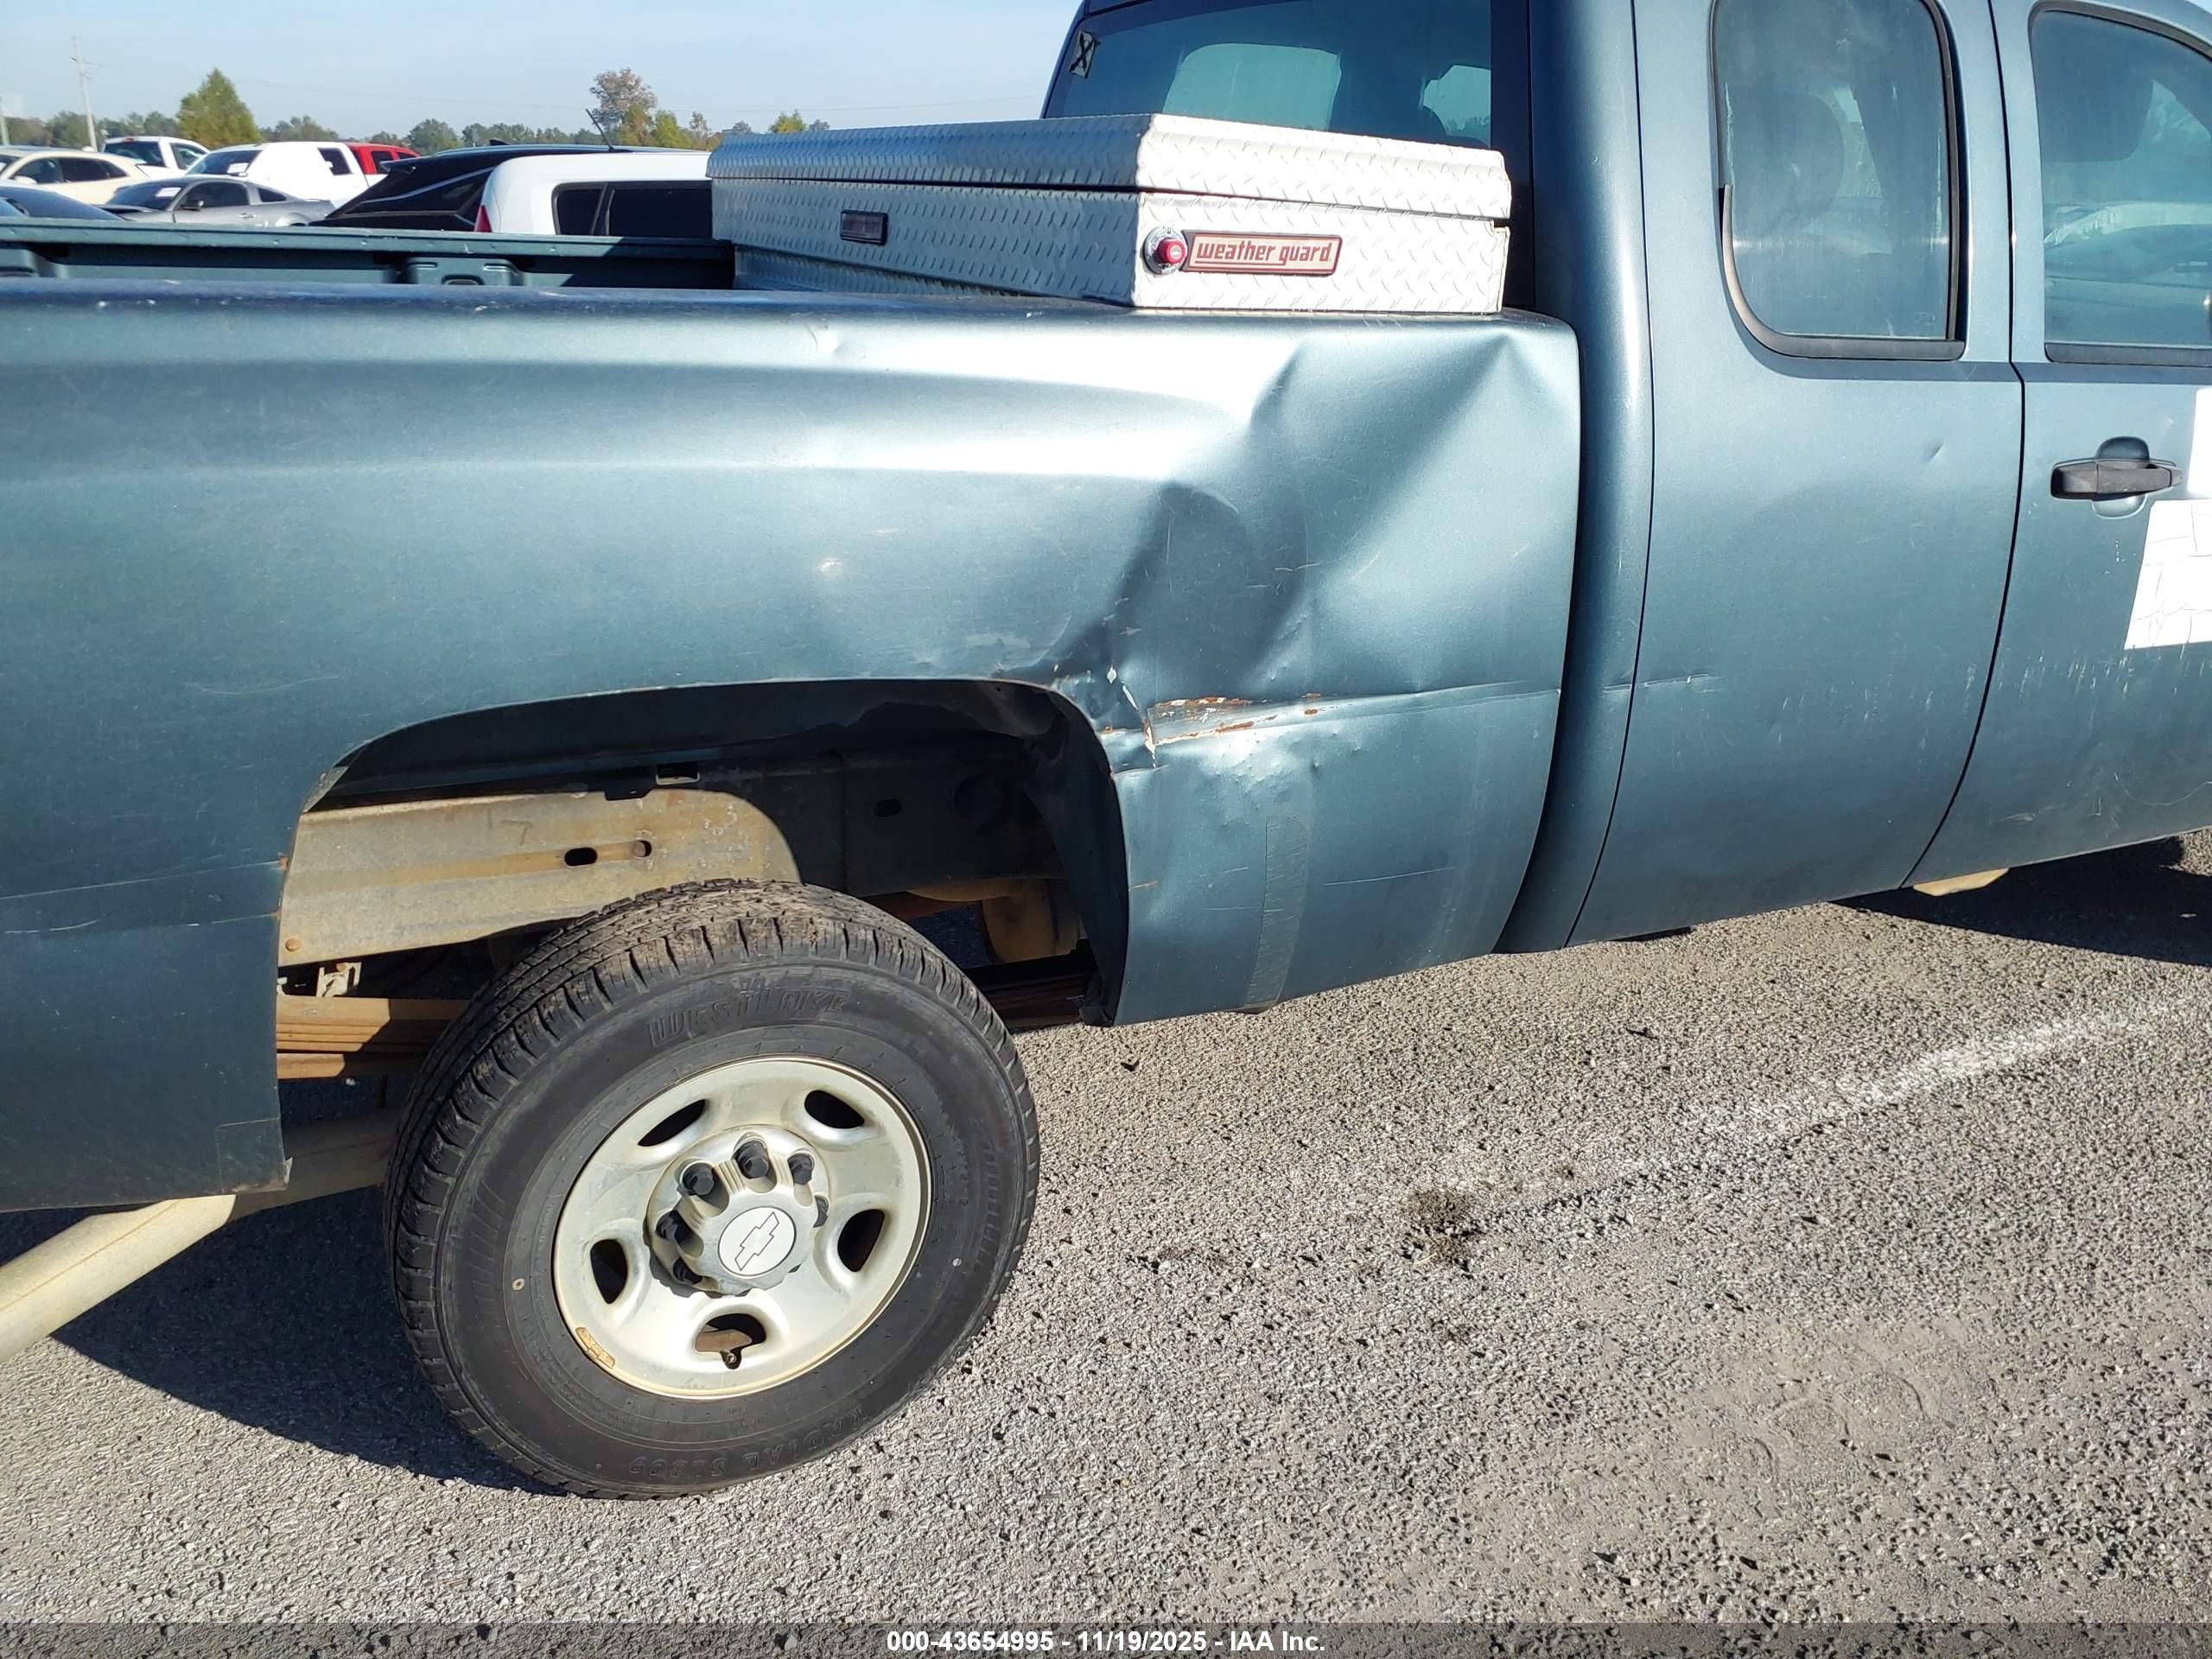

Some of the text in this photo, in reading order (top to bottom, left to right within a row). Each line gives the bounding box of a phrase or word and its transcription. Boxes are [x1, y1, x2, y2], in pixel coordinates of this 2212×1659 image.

[1196, 240, 1333, 265] weather guard
[647, 988, 850, 1048] WESTLAKE
